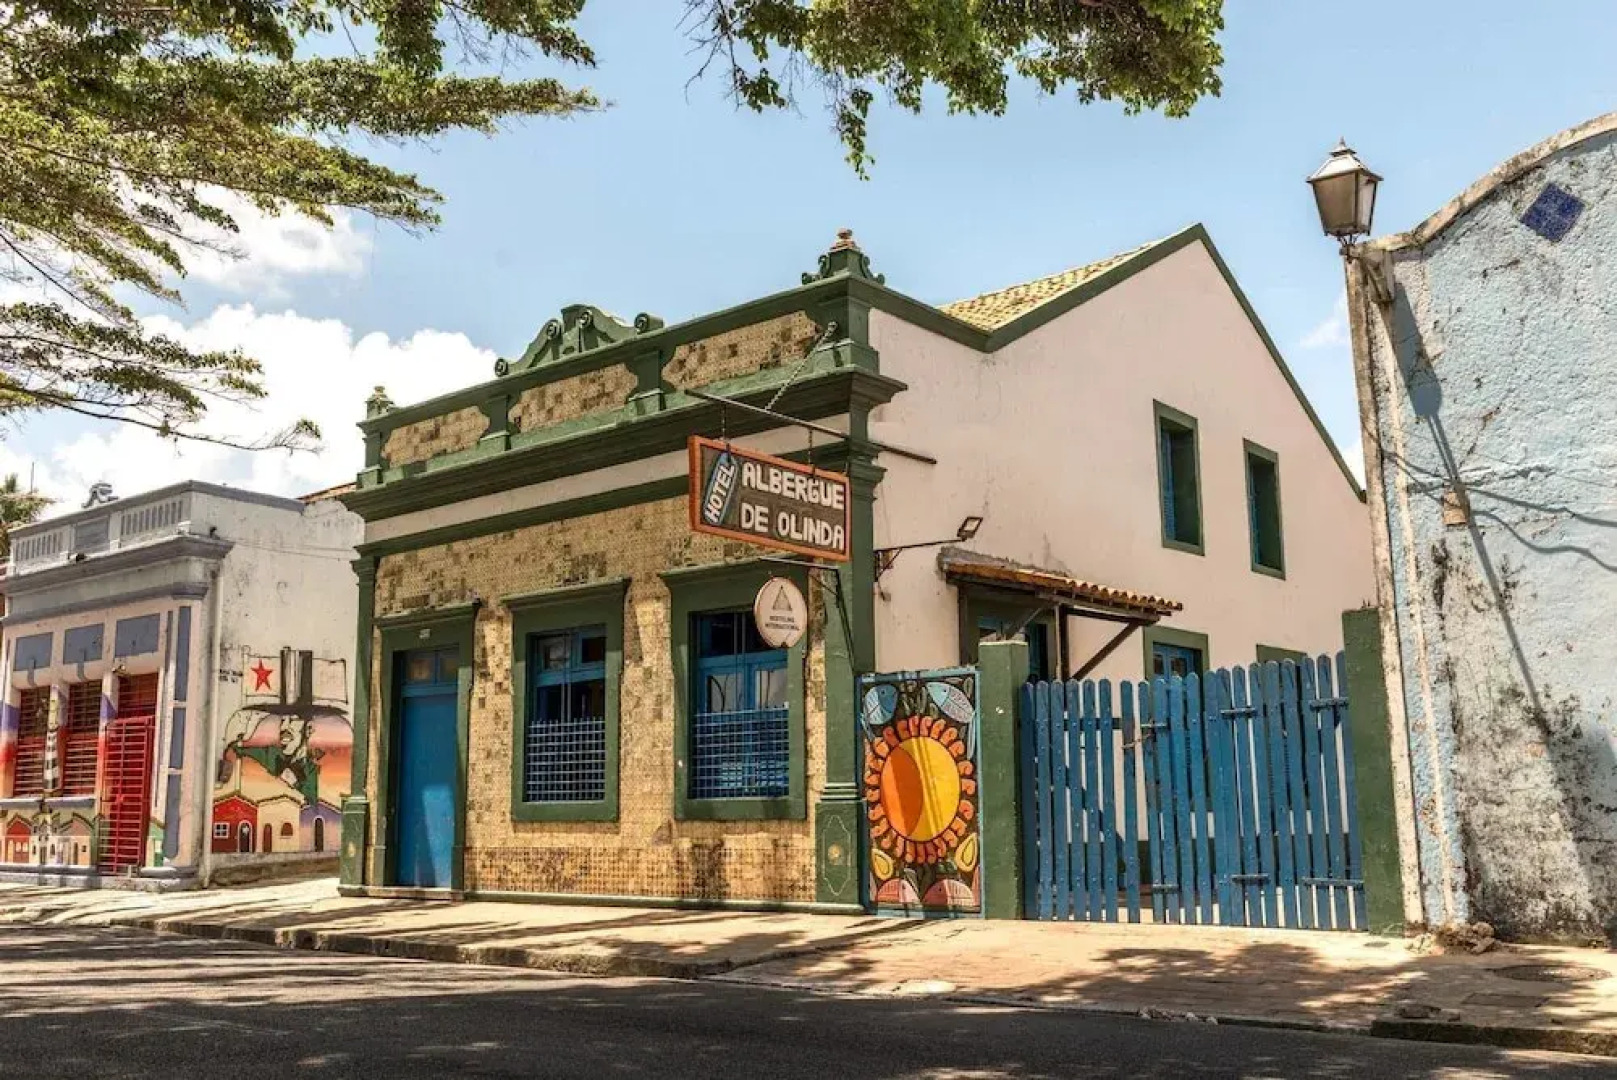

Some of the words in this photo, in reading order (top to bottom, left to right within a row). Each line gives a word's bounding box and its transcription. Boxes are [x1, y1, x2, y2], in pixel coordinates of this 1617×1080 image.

[704, 462, 735, 523] HOTEL
[743, 462, 845, 510] ALBERGUE
[741, 503, 769, 533] DE
[777, 512, 845, 551] OLINDA
